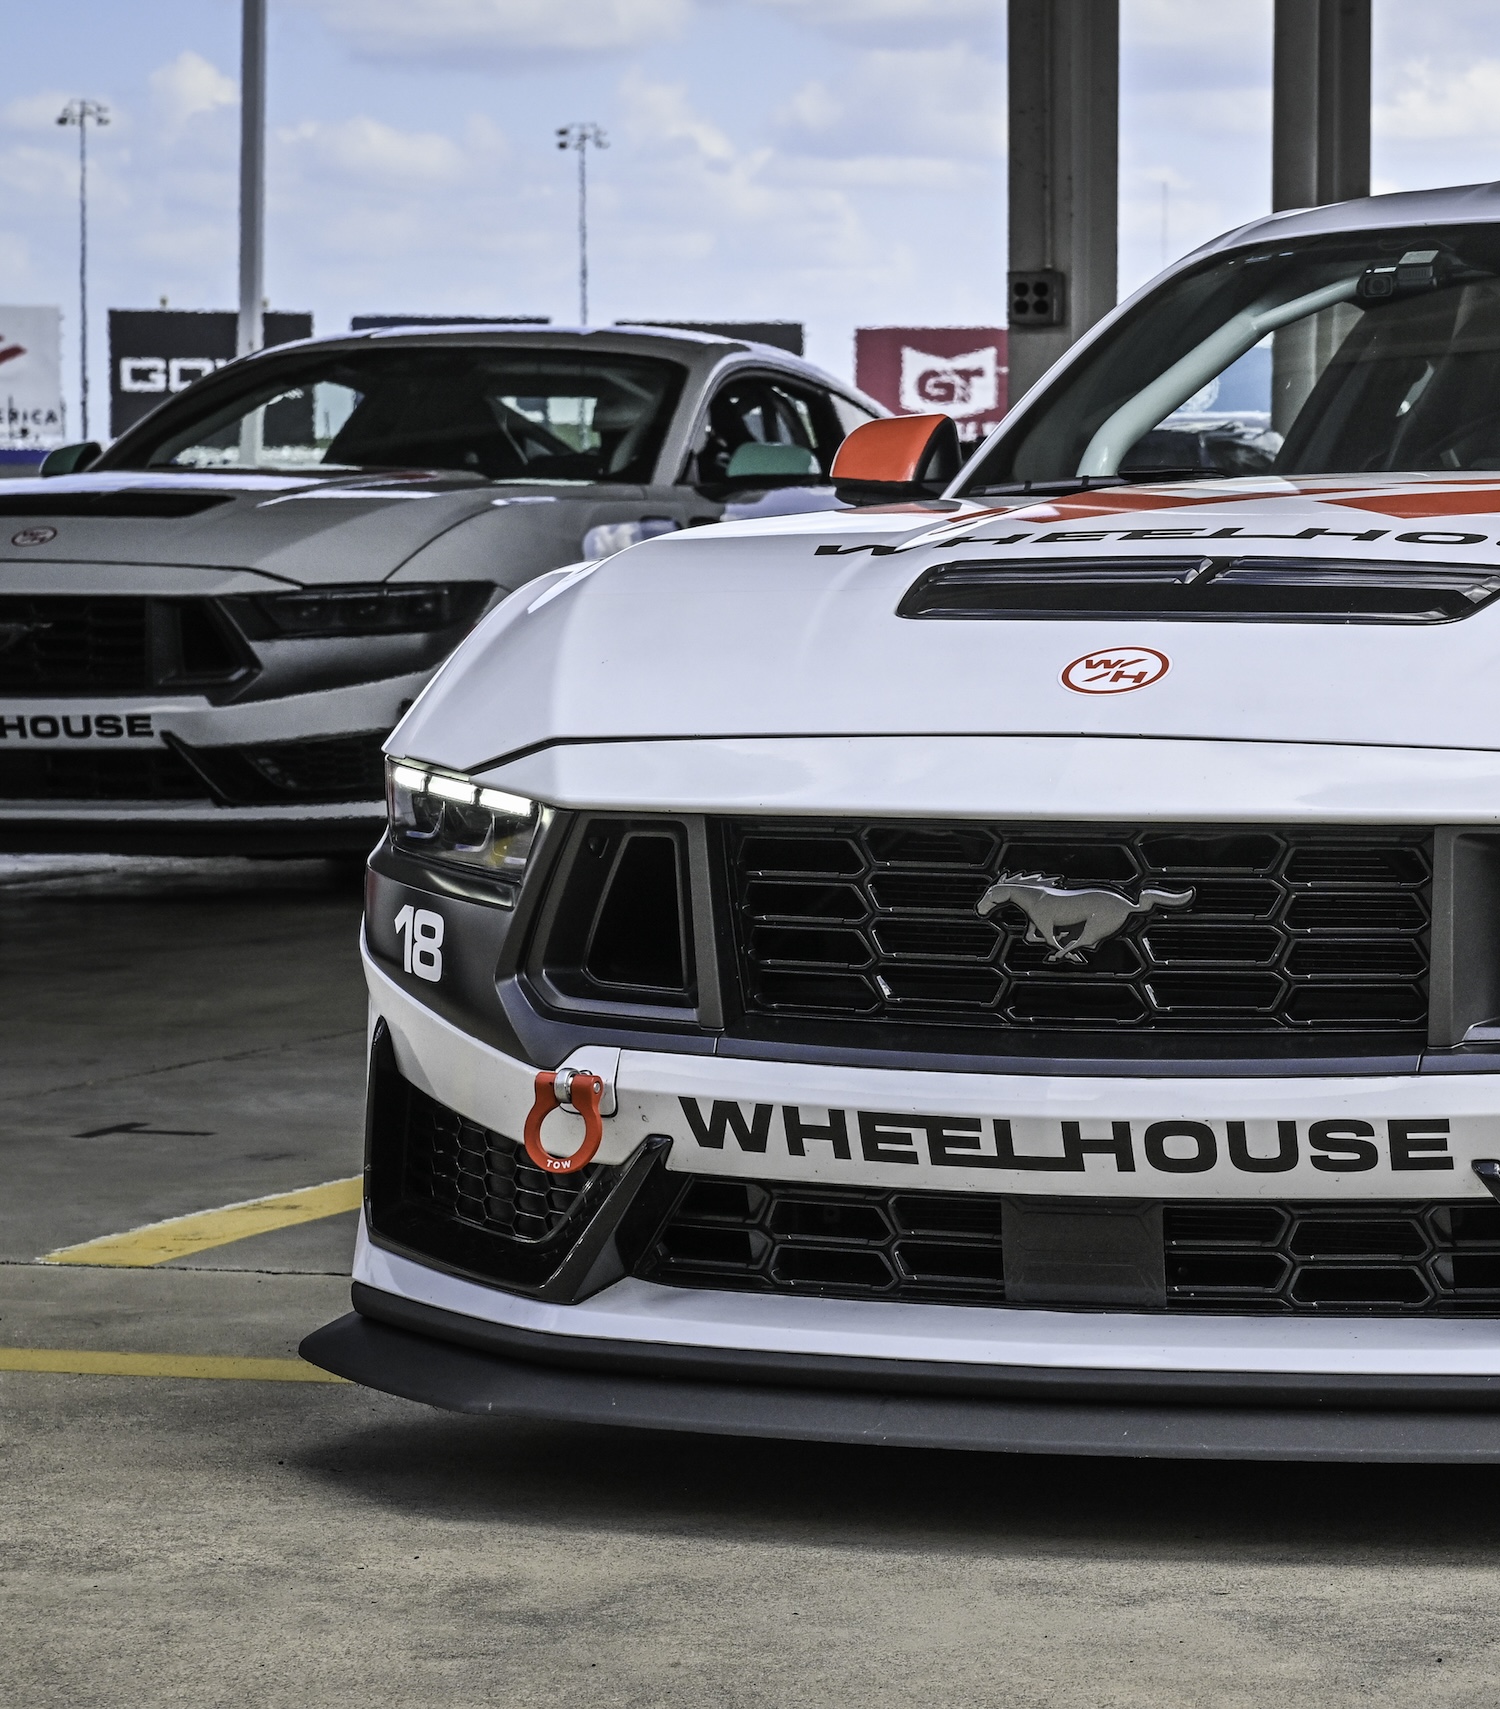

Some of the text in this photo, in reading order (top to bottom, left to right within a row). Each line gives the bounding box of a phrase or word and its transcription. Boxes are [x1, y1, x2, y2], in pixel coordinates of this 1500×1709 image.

[119, 357, 227, 393] GO
[917, 369, 974, 404] GT
[0, 714, 154, 739] HOUSE
[394, 904, 445, 982] 18
[678, 1095, 1455, 1174] WHEELHOUSE
[546, 1159, 571, 1169] TOW
